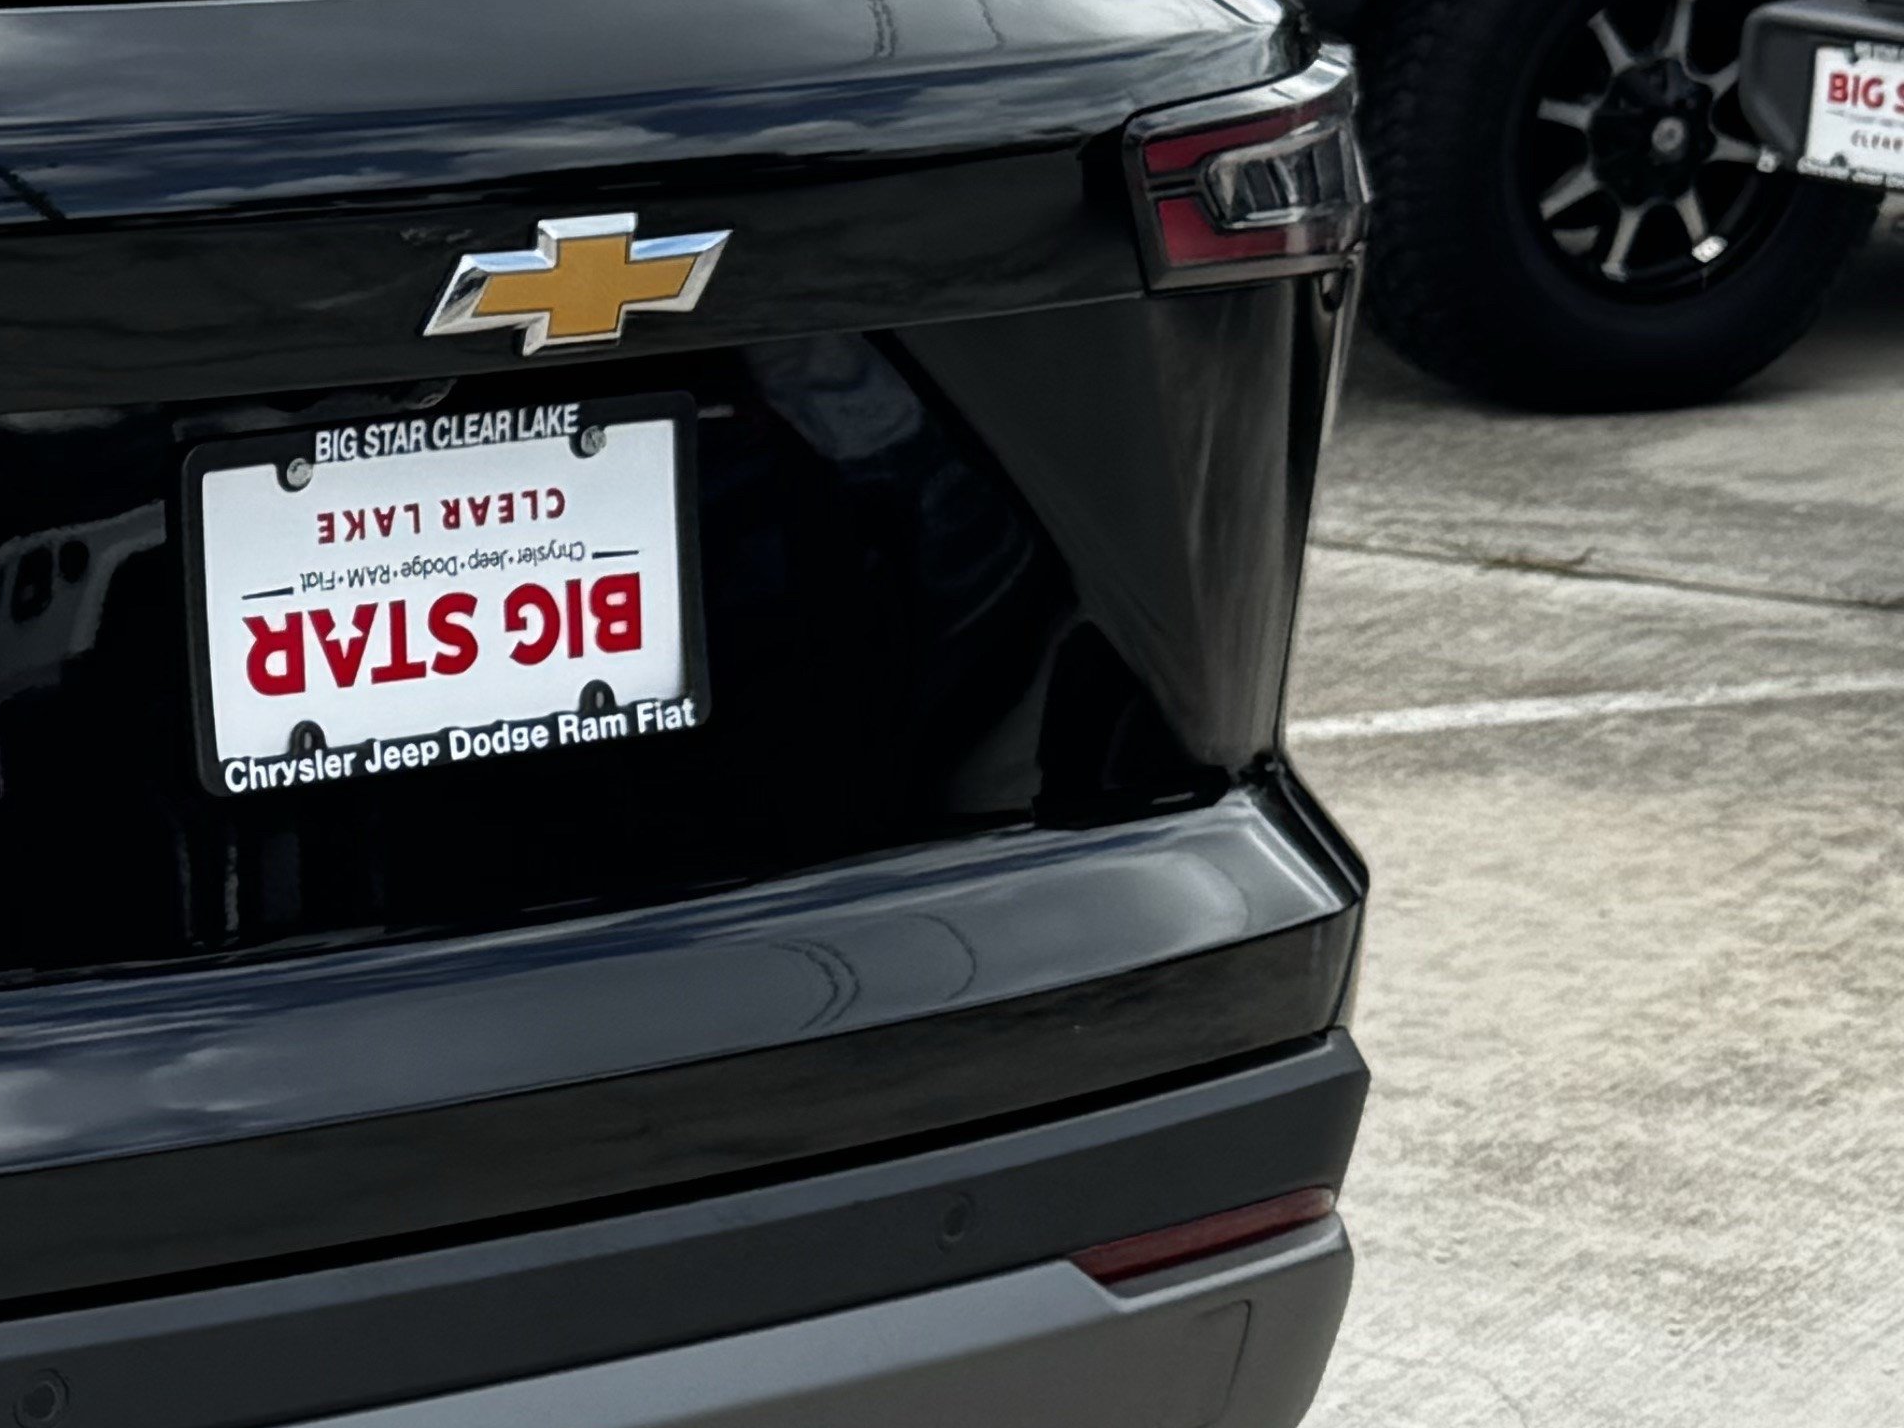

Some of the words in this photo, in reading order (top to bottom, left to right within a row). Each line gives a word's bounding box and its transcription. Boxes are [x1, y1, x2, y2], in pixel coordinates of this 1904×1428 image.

[1827, 72, 1885, 109] BIG
[315, 427, 358, 462] BIG
[364, 419, 427, 456] STAR
[433, 410, 511, 449] CLEAR
[517, 403, 580, 439] LAKE
[316, 503, 421, 544] LAKE
[440, 487, 566, 530] CLEAR
[242, 591, 479, 696] STAR
[504, 572, 643, 666] BIG
[224, 747, 357, 793] Chrysler
[365, 738, 441, 774] Jeep
[449, 720, 550, 762] Dodge
[557, 709, 628, 745] Ram
[635, 698, 697, 735] Fiat
